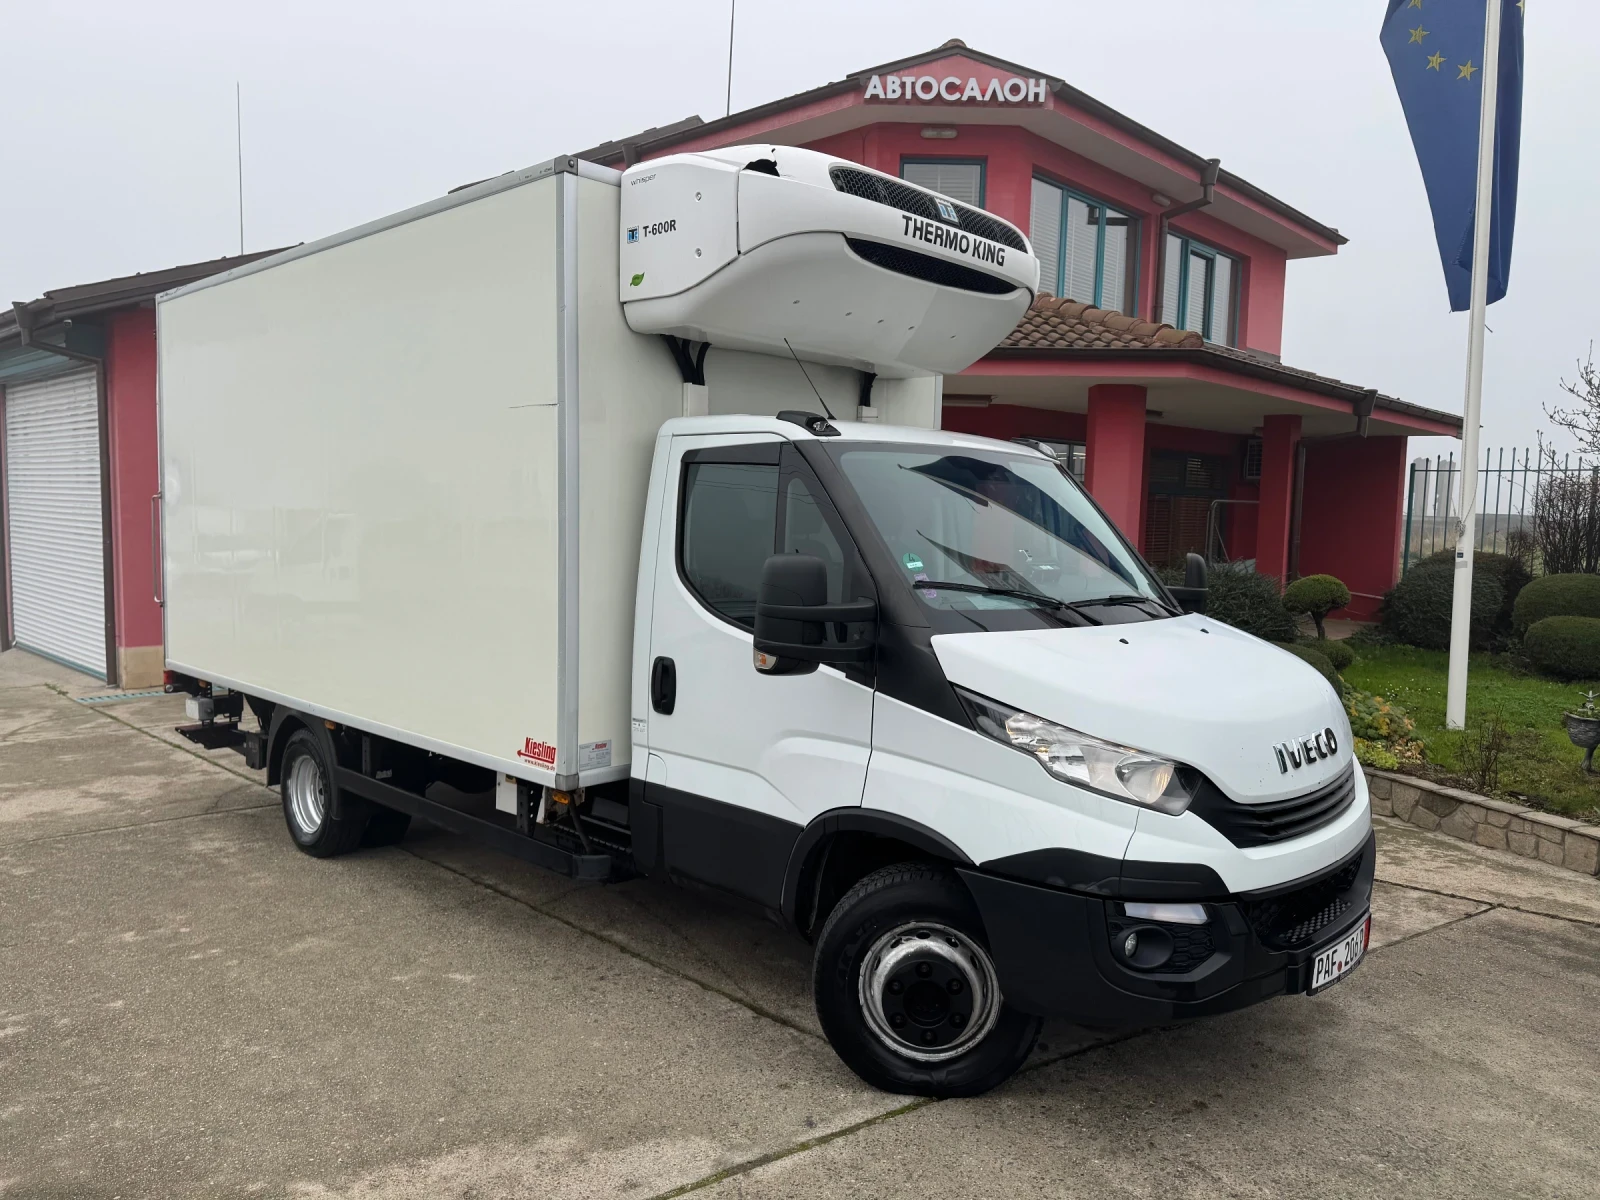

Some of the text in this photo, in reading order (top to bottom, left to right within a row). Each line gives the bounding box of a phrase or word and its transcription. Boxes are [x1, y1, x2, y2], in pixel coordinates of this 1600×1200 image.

[864, 75, 1047, 103] АВТОСАЛОН
[630, 174, 657, 186] whisper
[643, 219, 677, 238] T-600R
[902, 214, 1006, 267] THERMO KING
[525, 736, 557, 762] Kiesling
[1272, 727, 1338, 775] IVECO
[1315, 949, 1338, 985] PAF
